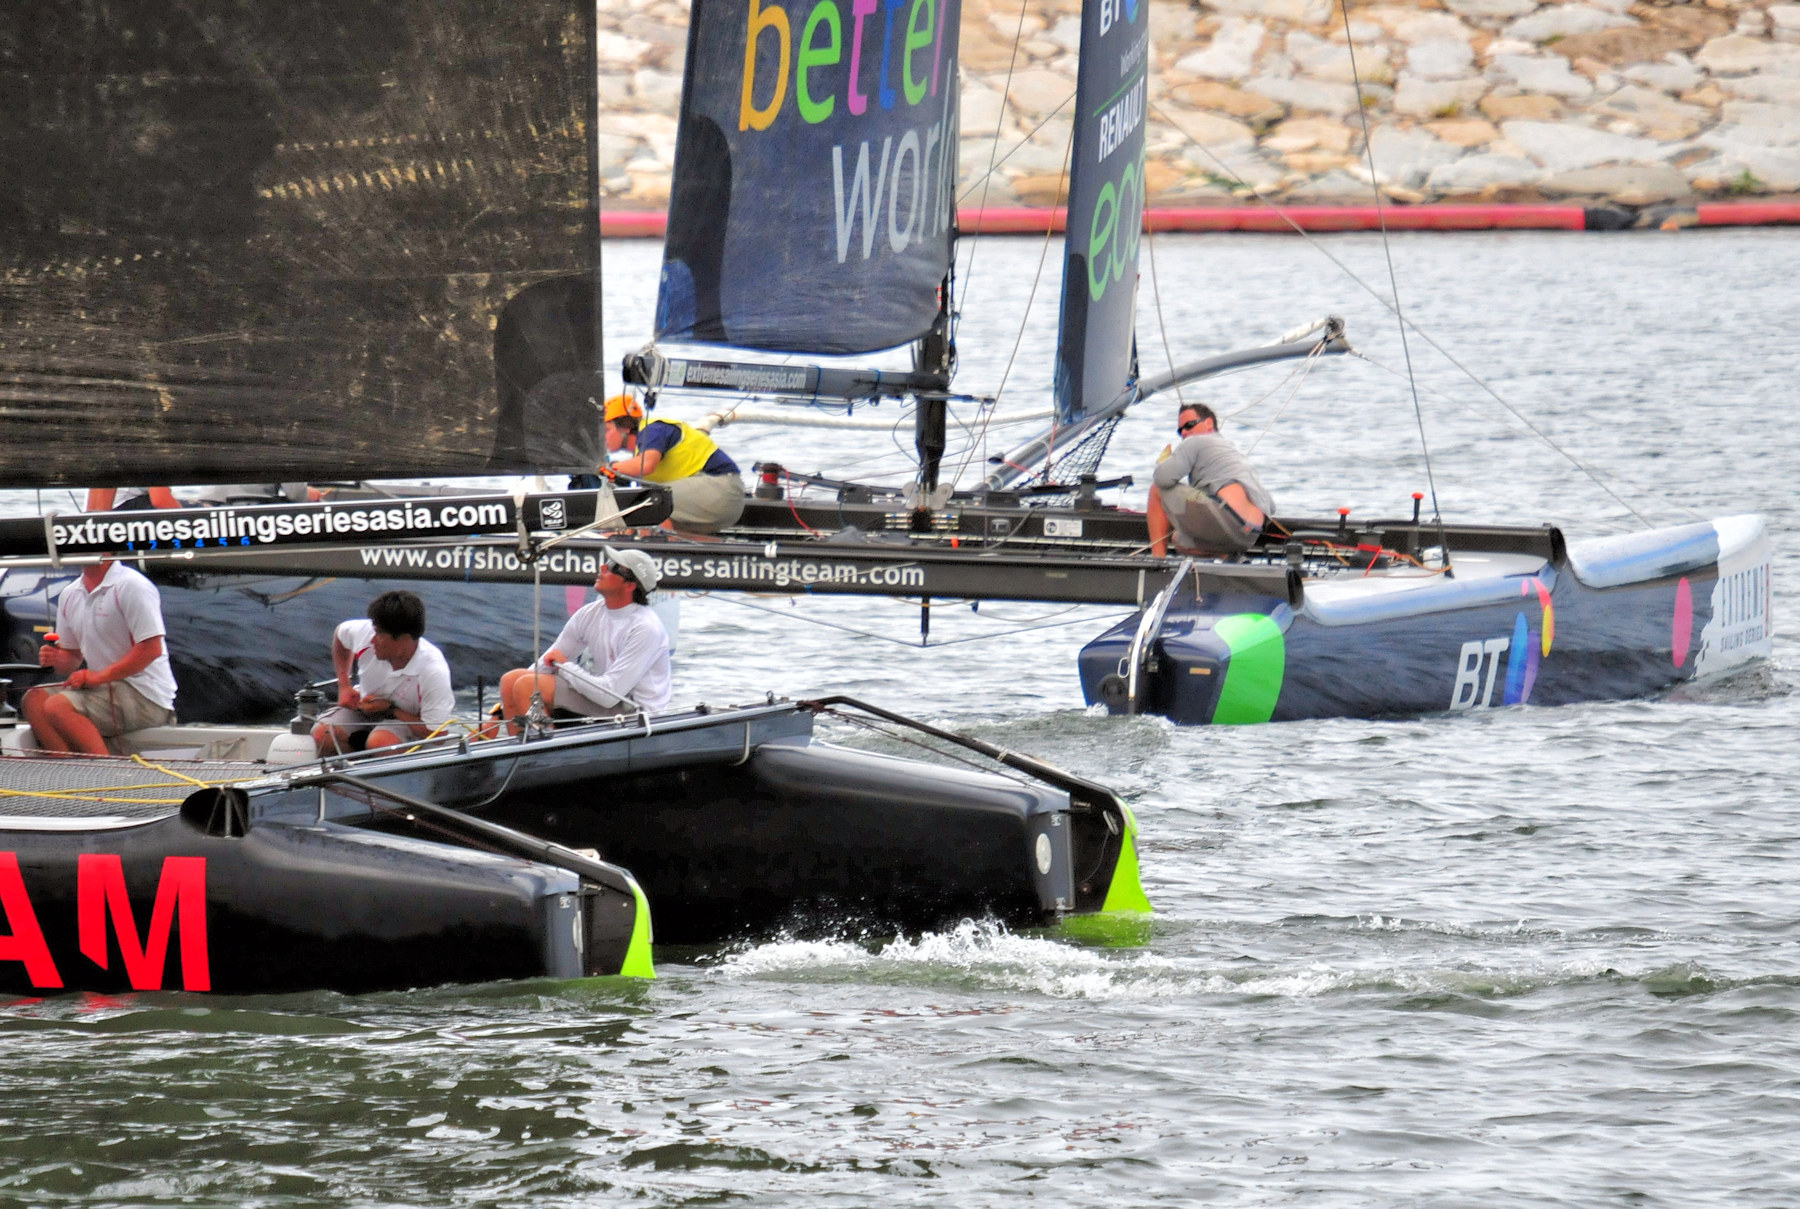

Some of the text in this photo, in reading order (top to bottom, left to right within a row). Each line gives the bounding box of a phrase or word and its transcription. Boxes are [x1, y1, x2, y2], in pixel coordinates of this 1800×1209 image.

[1098, 75, 1145, 163] RENAULT
[53, 503, 508, 545] extremesailingseriesasia.com
[1449, 637, 1510, 711] BT
